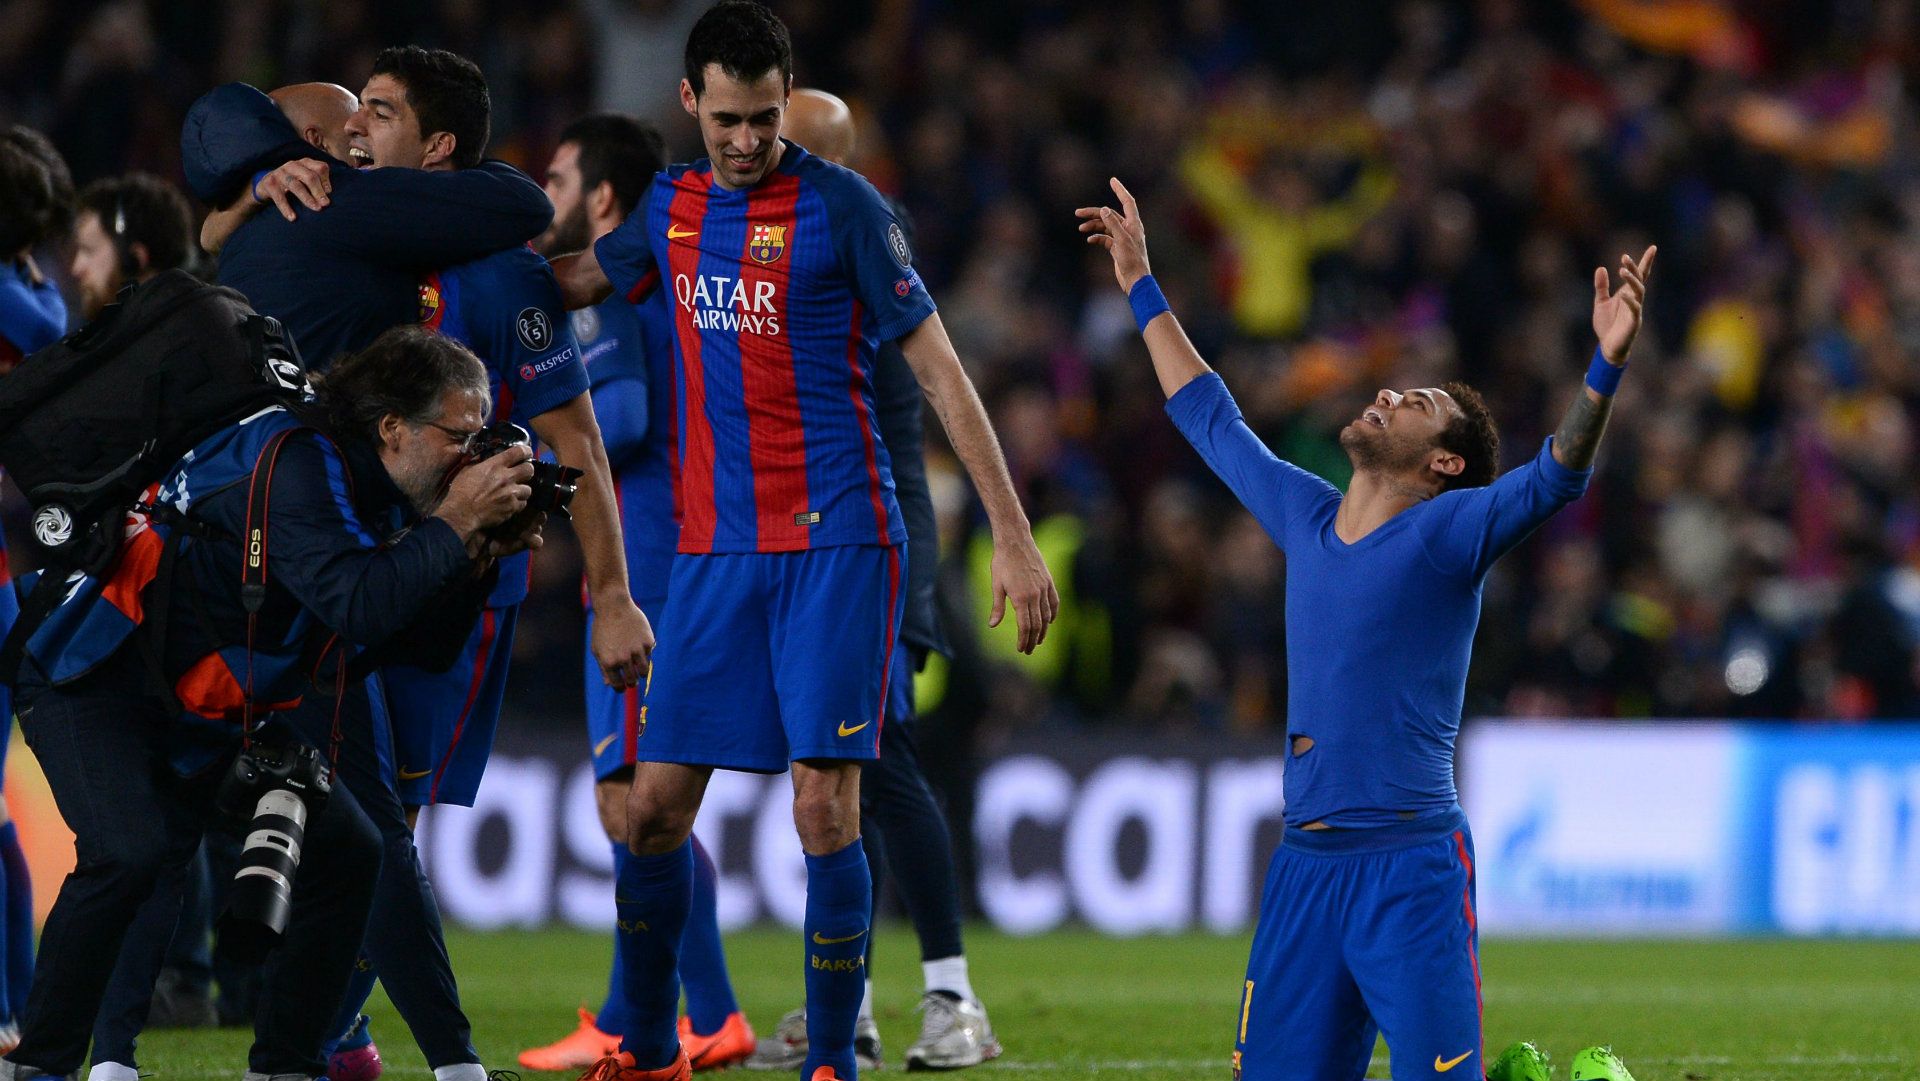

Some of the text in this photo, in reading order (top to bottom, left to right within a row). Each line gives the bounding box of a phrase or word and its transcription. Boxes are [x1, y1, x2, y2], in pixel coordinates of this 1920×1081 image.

[676, 274, 778, 313] QATAR
[532, 327, 541, 341] 5
[692, 309, 780, 336] AIRWAYS
[534, 347, 573, 373] RESPECT
[249, 528, 261, 568] EOS
[812, 954, 865, 975] BARÇA
